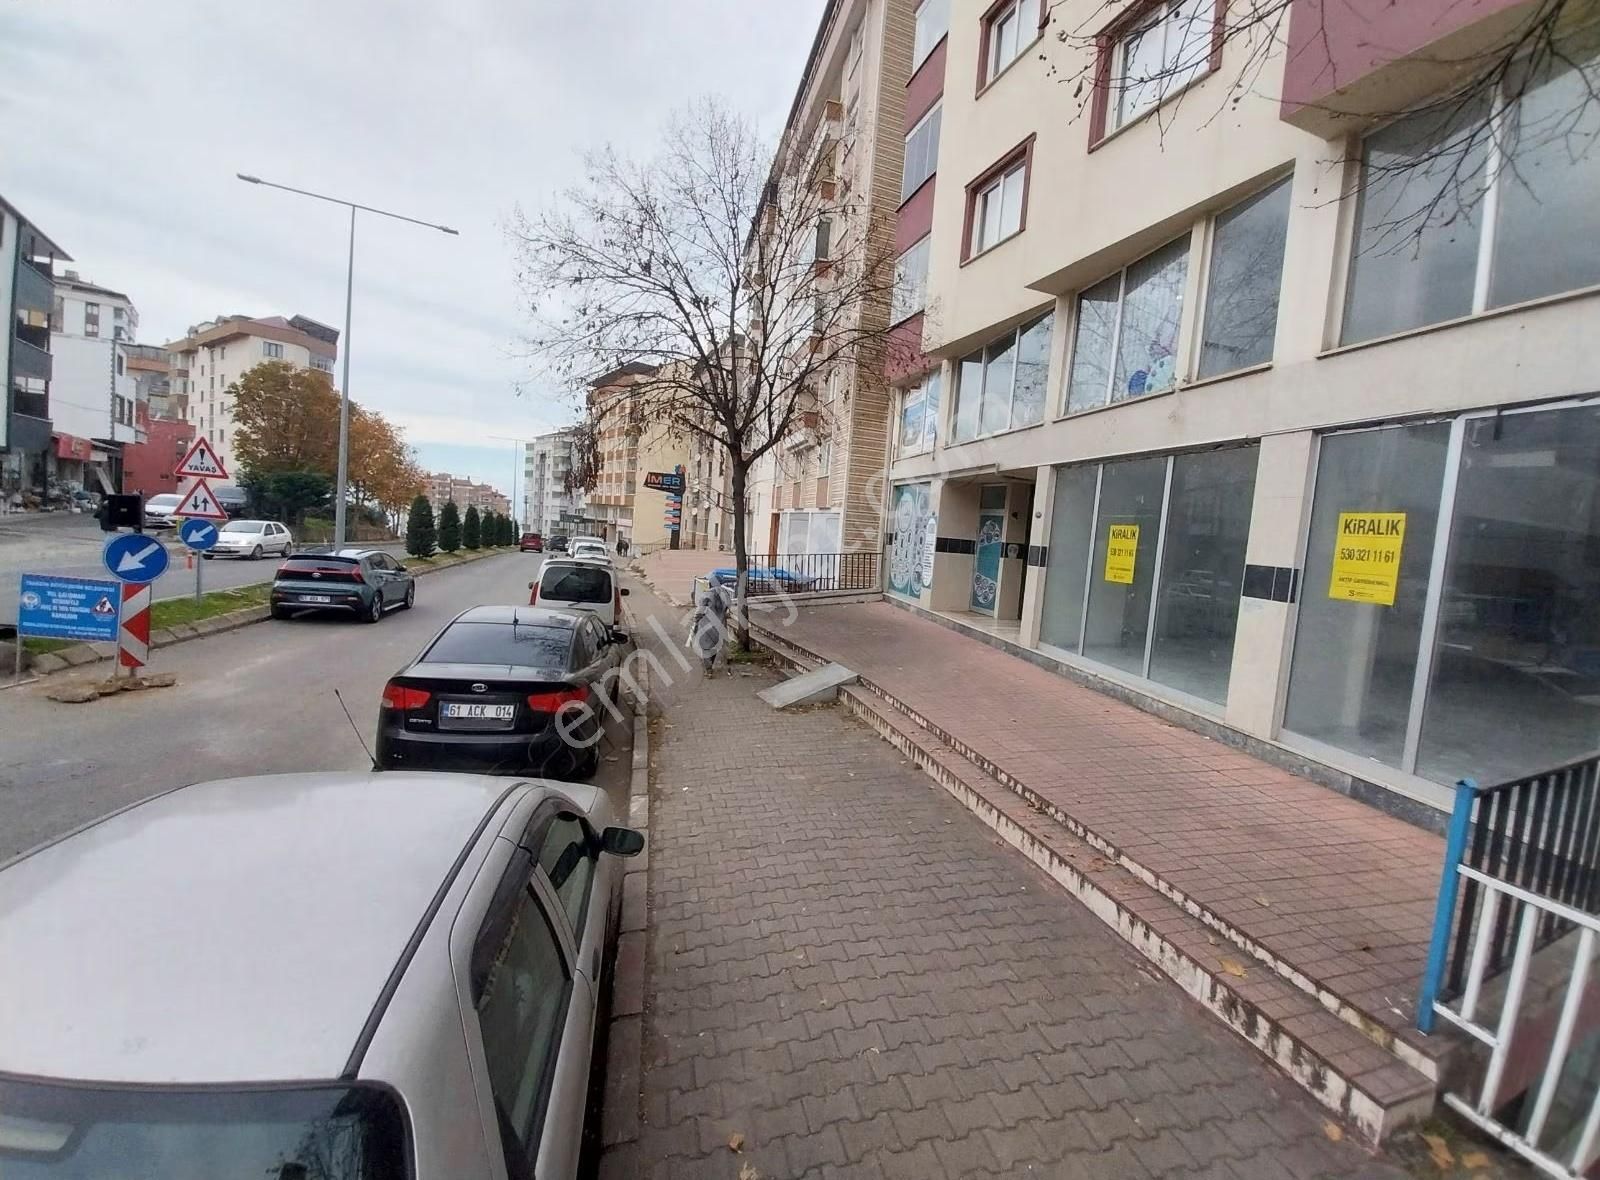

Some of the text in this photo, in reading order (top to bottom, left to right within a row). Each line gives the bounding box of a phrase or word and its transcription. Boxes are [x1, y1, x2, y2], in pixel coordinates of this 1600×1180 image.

[1341, 548, 1355, 561] 530
[1356, 548, 1370, 562] 321
[1384, 551, 1395, 564] 61
[449, 705, 512, 717] 61 ACK 014
